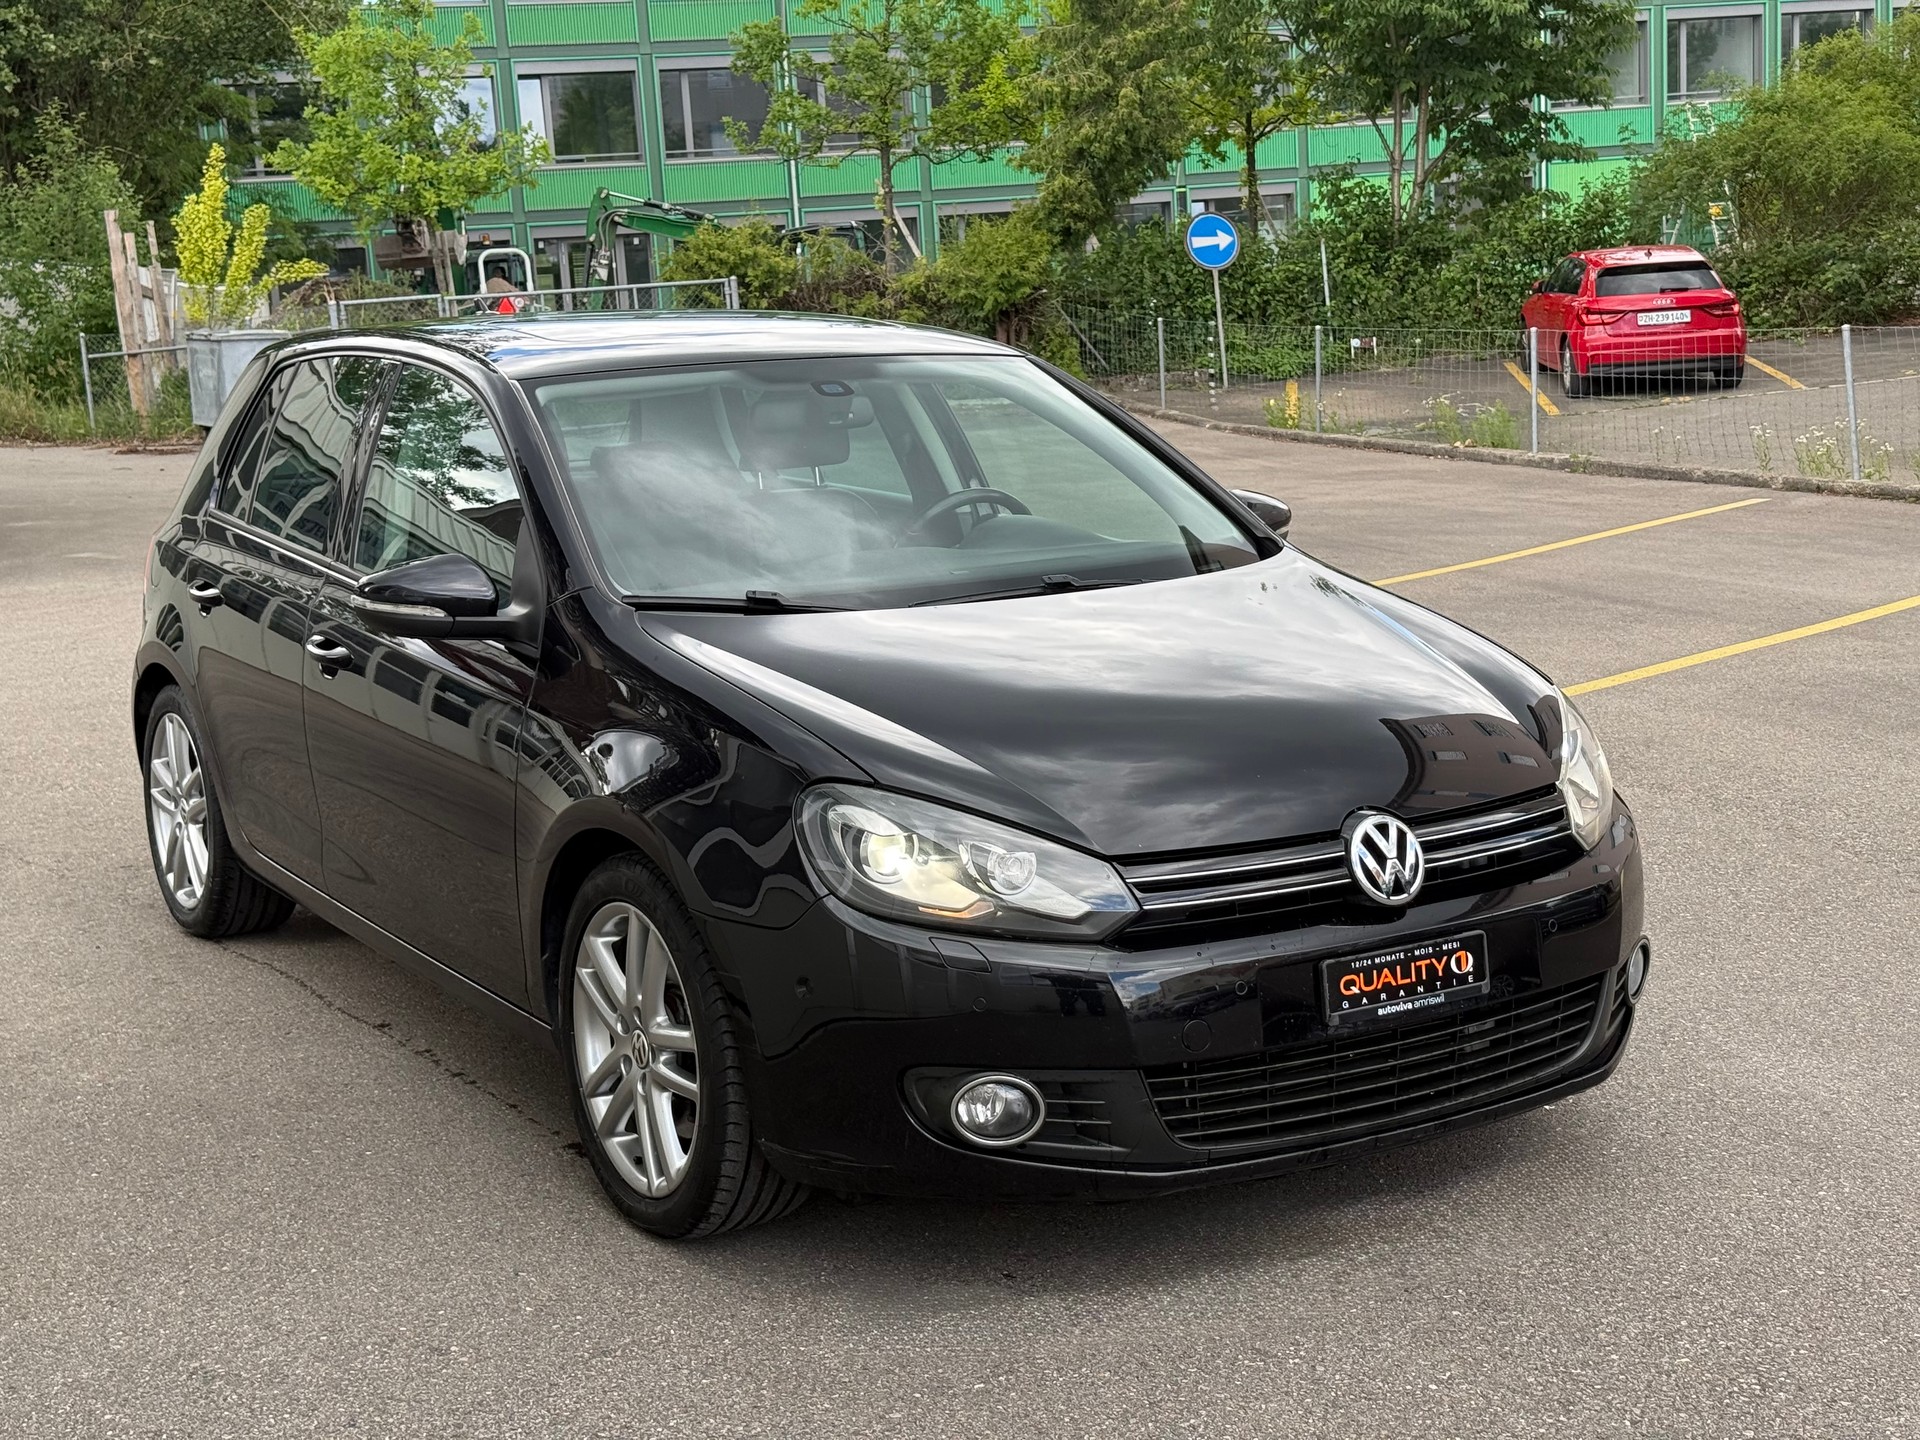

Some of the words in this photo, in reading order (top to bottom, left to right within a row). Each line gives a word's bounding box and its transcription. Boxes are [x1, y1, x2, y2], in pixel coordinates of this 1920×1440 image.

[1356, 818, 1418, 899] VW
[1351, 959, 1372, 969] 12/24
[1374, 952, 1405, 964] MONATE
[1414, 946, 1433, 956] MOIS
[1442, 941, 1460, 951] MESI
[1340, 955, 1448, 996] QUALITY
[1342, 974, 1474, 1009] GARANTIE
[1377, 1001, 1413, 1016] autoviva
[1413, 992, 1445, 1008] amriswil
